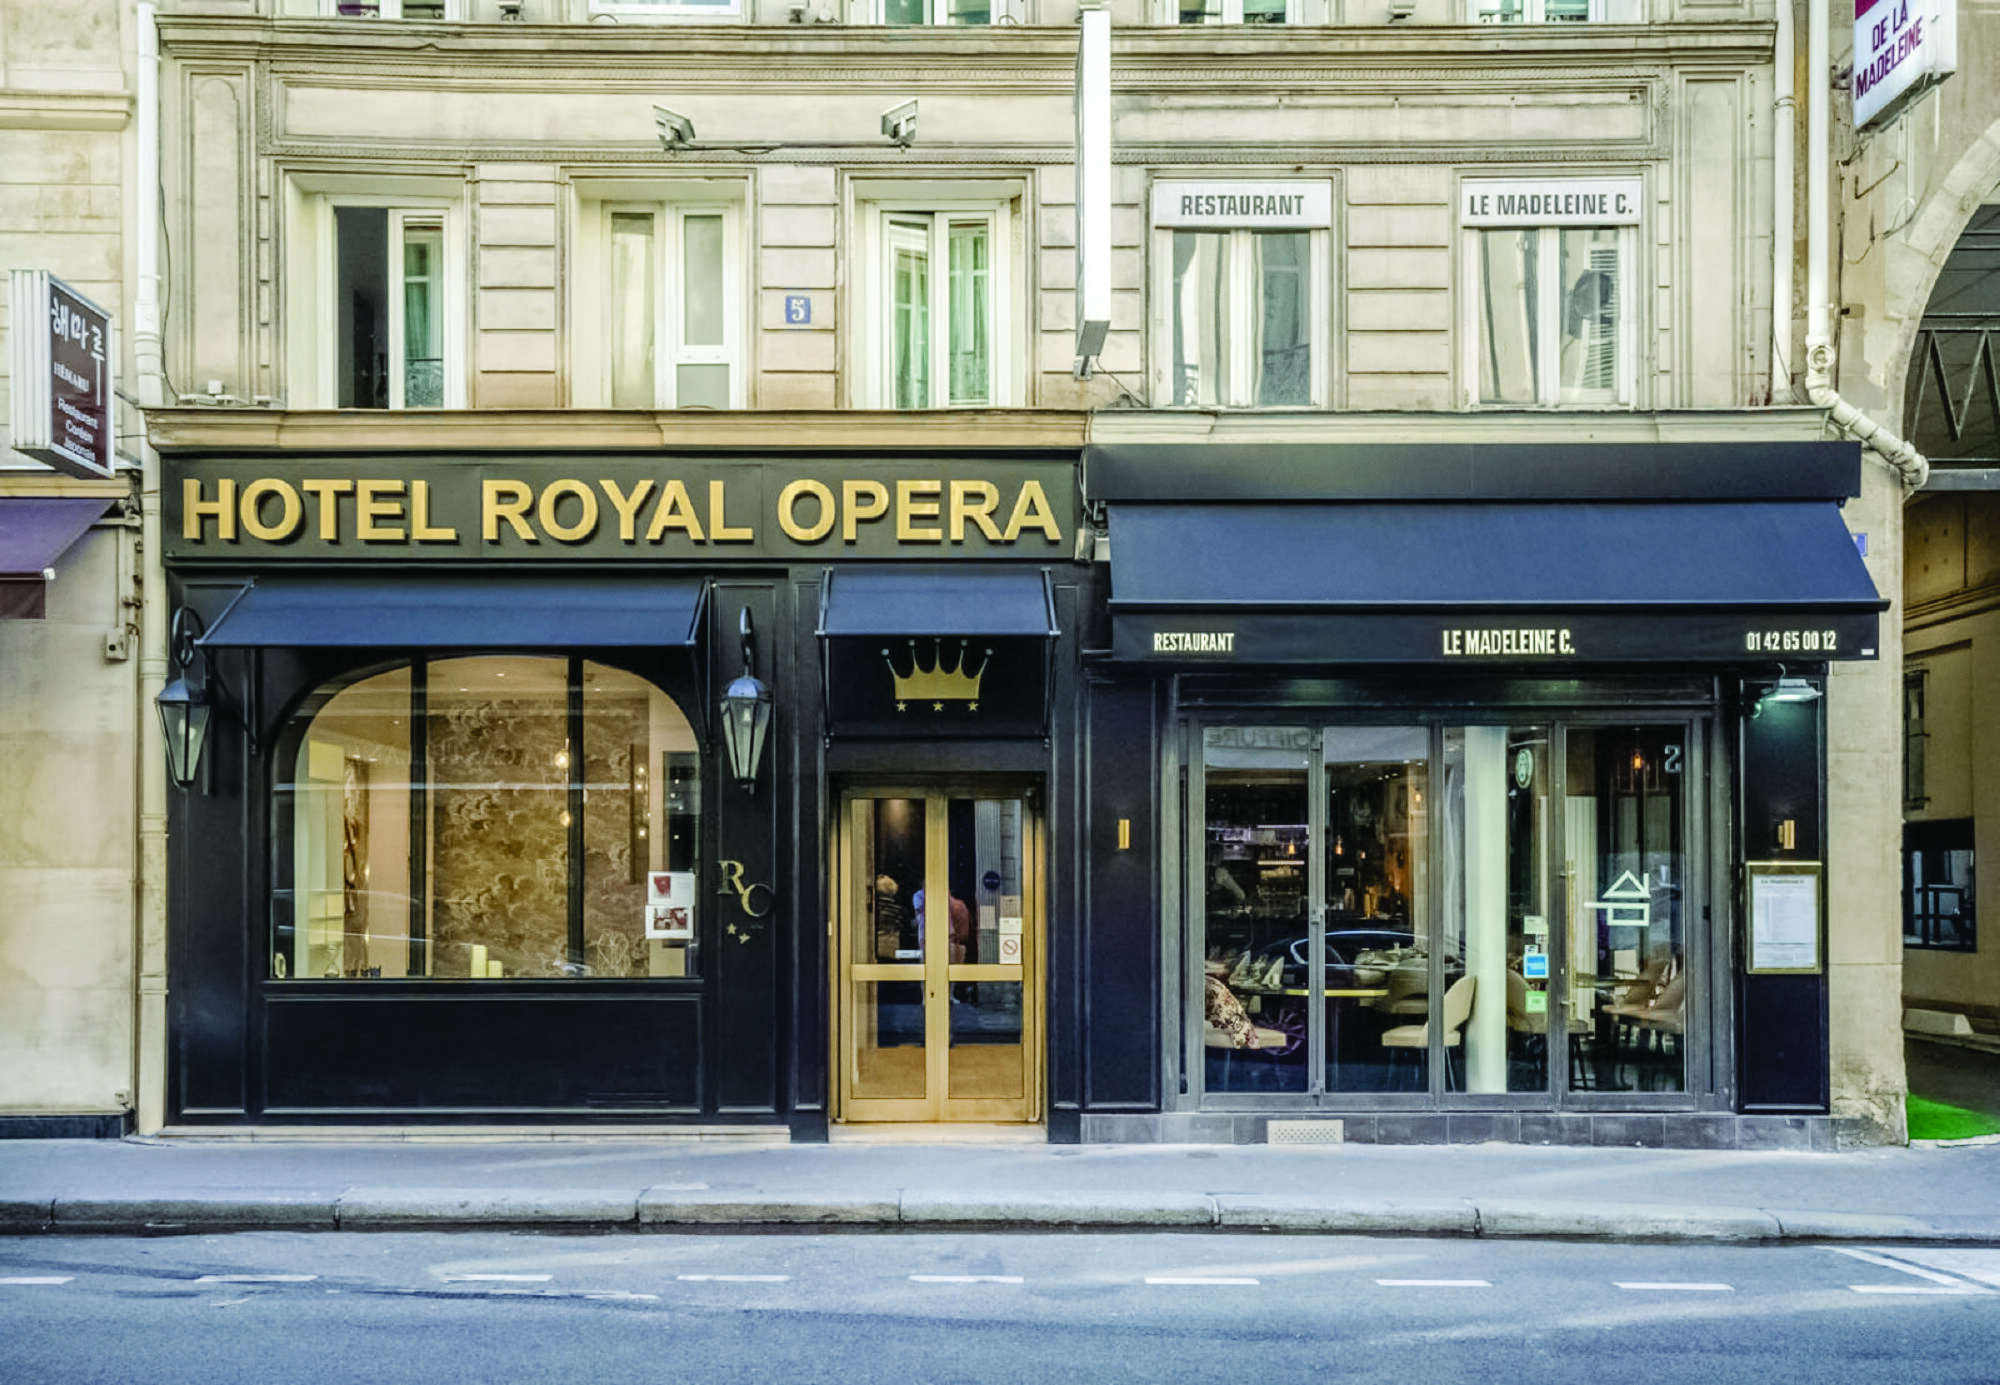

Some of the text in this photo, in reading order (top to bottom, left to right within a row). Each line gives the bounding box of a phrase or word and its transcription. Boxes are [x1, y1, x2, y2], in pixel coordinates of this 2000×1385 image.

[1872, 0, 1908, 52] DE LA
[1856, 16, 1923, 100] MADELEINE
[1181, 195, 1304, 216] RESTAURANT
[1469, 194, 1634, 215] LE MADELEINE C.
[792, 299, 805, 321] 5
[182, 478, 1062, 541] HOTEL ROYAL OPERA
[1153, 632, 1235, 651] RESTAURANT
[1443, 629, 1575, 655] LE MADELEINE C.
[1746, 630, 1837, 650] 01 42 65 00 12
